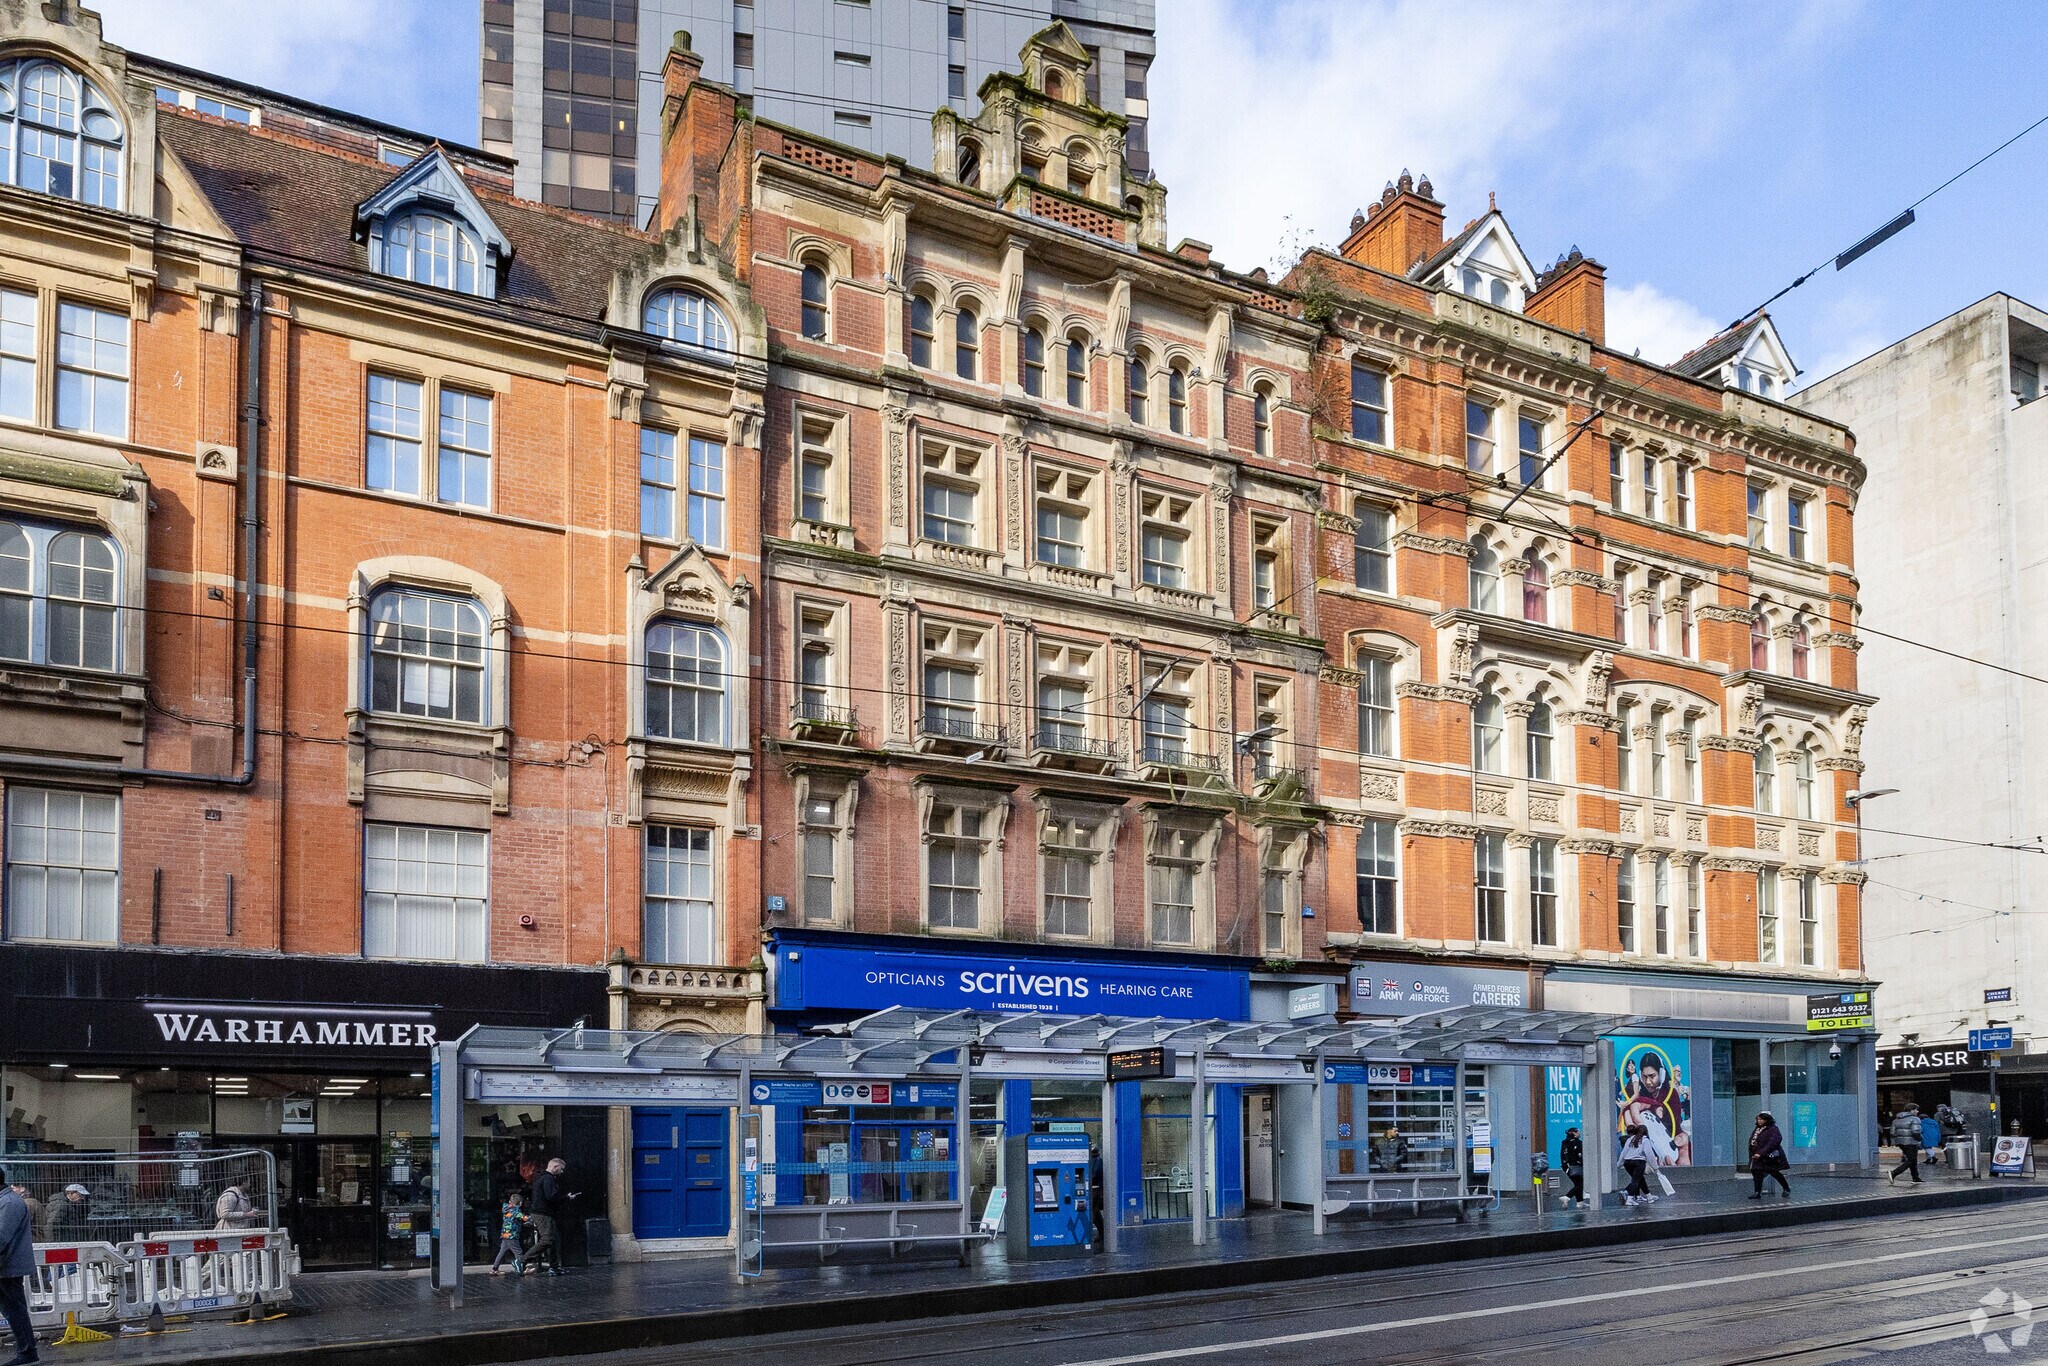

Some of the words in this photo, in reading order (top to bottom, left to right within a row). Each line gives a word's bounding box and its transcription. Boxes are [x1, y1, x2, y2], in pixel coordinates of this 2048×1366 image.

[865, 971, 945, 987] OPTICIANS
[959, 965, 1089, 998] scrivens
[1100, 983, 1157, 997] HEARING
[1160, 986, 1193, 998] CARE
[1424, 985, 1450, 994] ROYAL
[1473, 983, 1496, 993] ARMED
[1497, 985, 1520, 994] FORCES
[1379, 991, 1403, 1001] ARMY
[1408, 993, 1424, 1002] AIR
[1424, 994, 1450, 1003] FORCE
[1473, 991, 1520, 1007] CAREERS
[1293, 1001, 1320, 1013] CAREERS
[1811, 1007, 1830, 1015] 0121
[1848, 1004, 1868, 1012] 9337
[1819, 1020, 1836, 1028] TO
[1840, 1018, 1860, 1026] LET
[153, 1013, 437, 1046] WARHAMMER
[1891, 1051, 1969, 1070] FRASER
[1549, 1066, 1581, 1091] NEW
[1550, 1093, 1574, 1114] DOES
